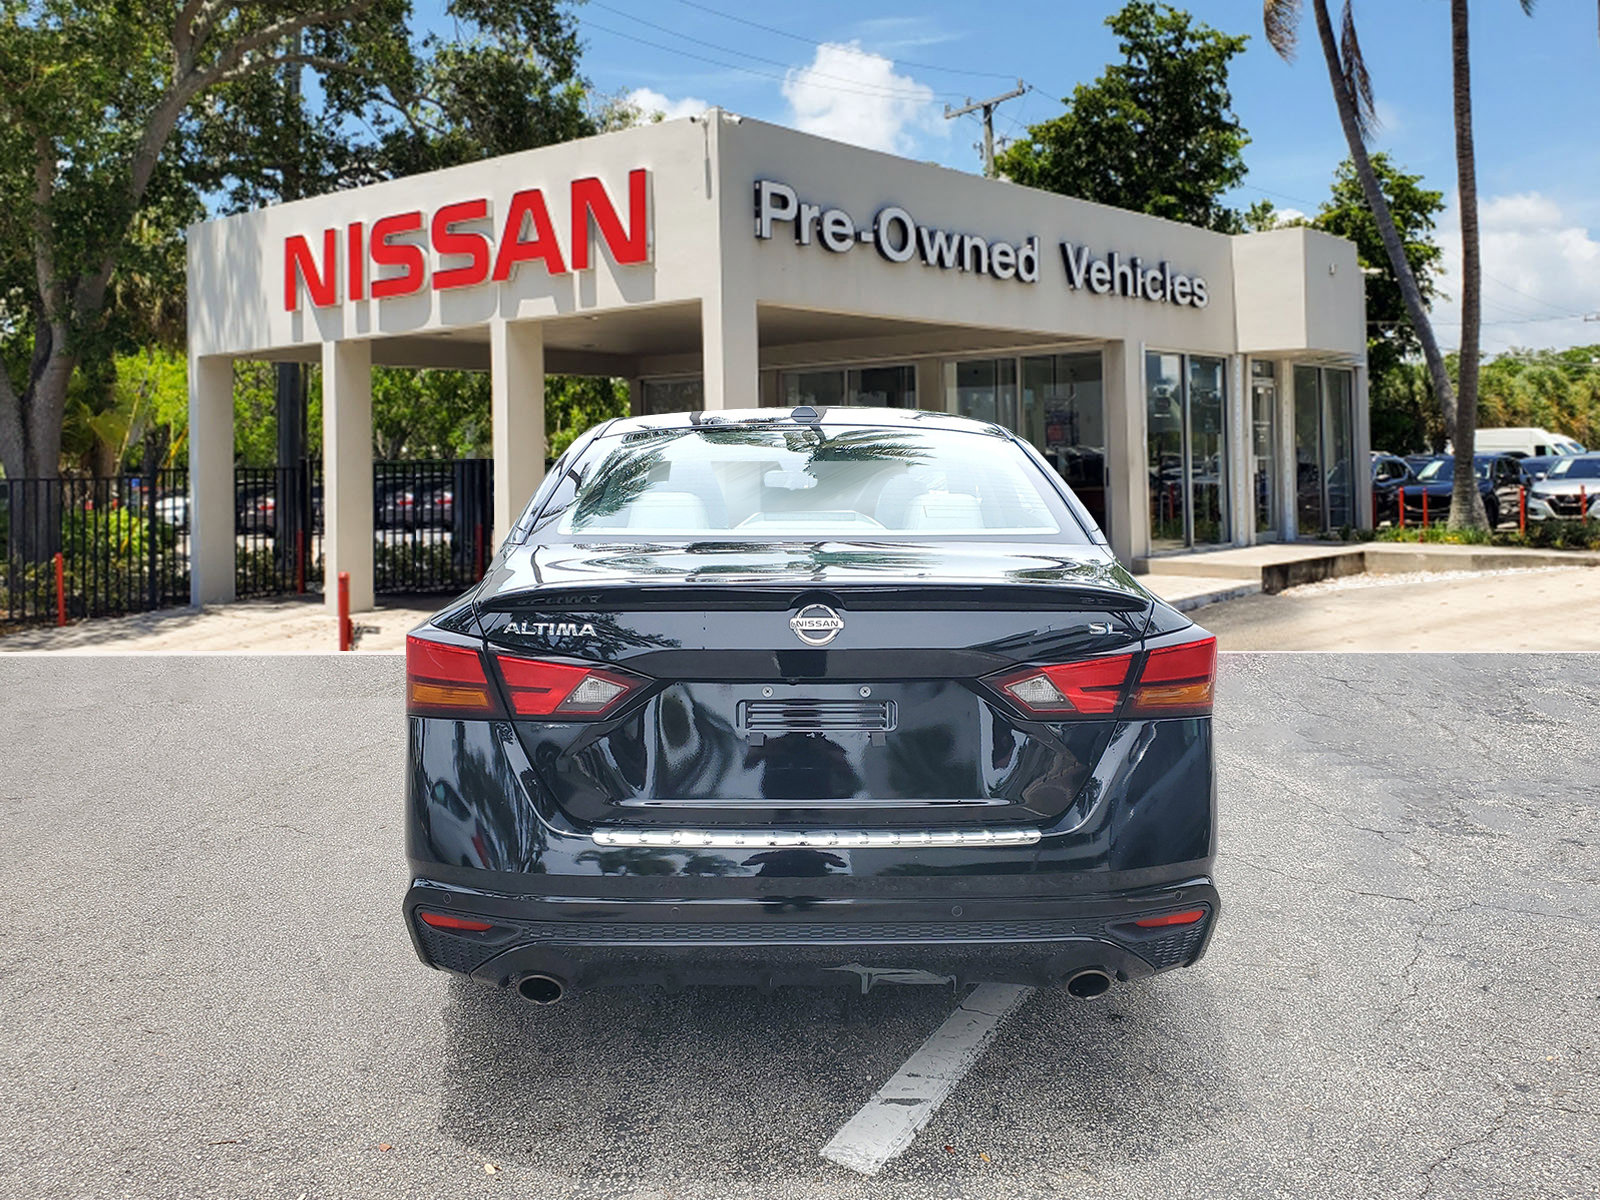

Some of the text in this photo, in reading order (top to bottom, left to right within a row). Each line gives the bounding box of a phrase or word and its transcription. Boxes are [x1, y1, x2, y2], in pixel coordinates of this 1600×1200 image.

[284, 167, 649, 312] NISSAN
[755, 180, 1208, 308] Pre-Owned Vehicles
[503, 621, 598, 638] ALTIMA
[796, 619, 839, 628] NISSAN
[1088, 622, 1124, 635] SL
